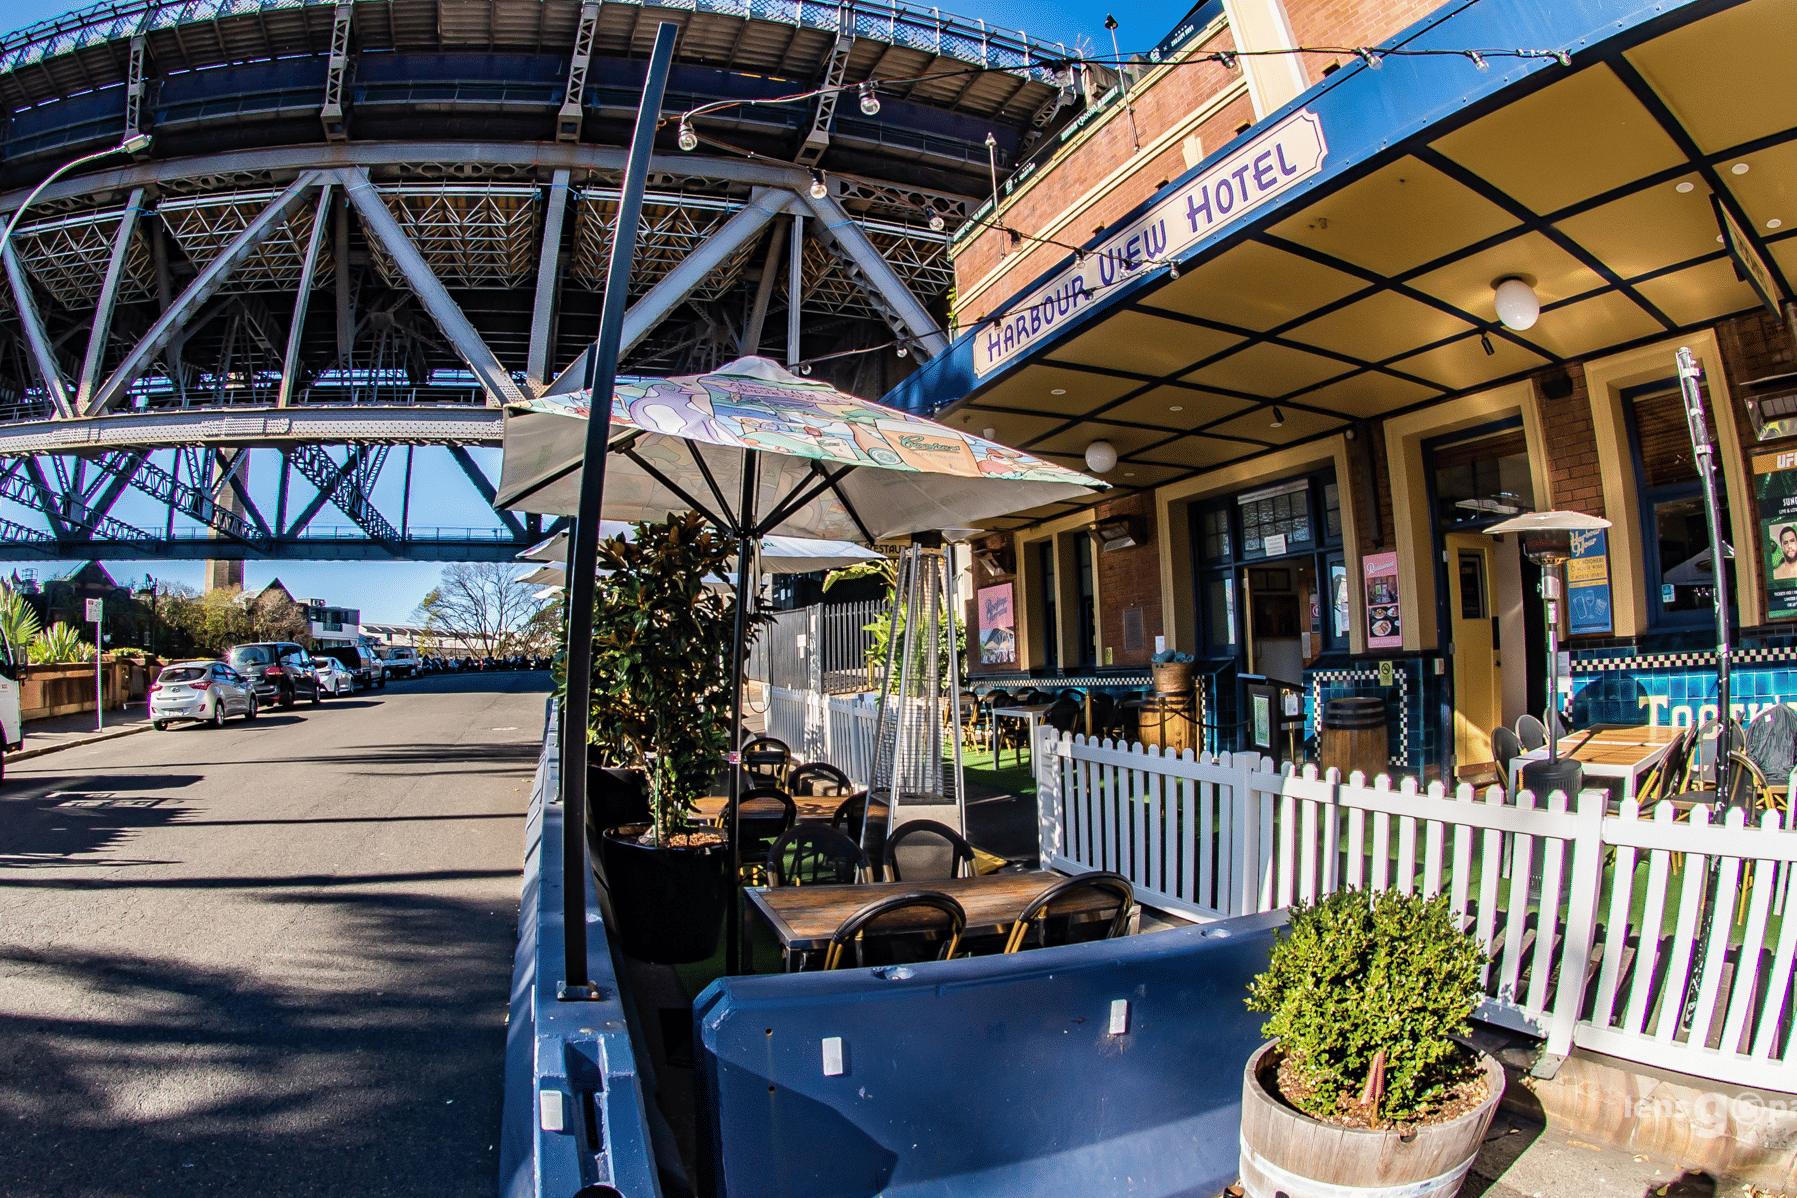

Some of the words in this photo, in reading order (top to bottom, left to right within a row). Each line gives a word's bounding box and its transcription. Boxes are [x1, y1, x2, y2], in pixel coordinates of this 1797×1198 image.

[987, 275, 1090, 363] HARBOUR
[1099, 218, 1167, 287] VIEW
[1186, 142, 1297, 234] HOTEL
